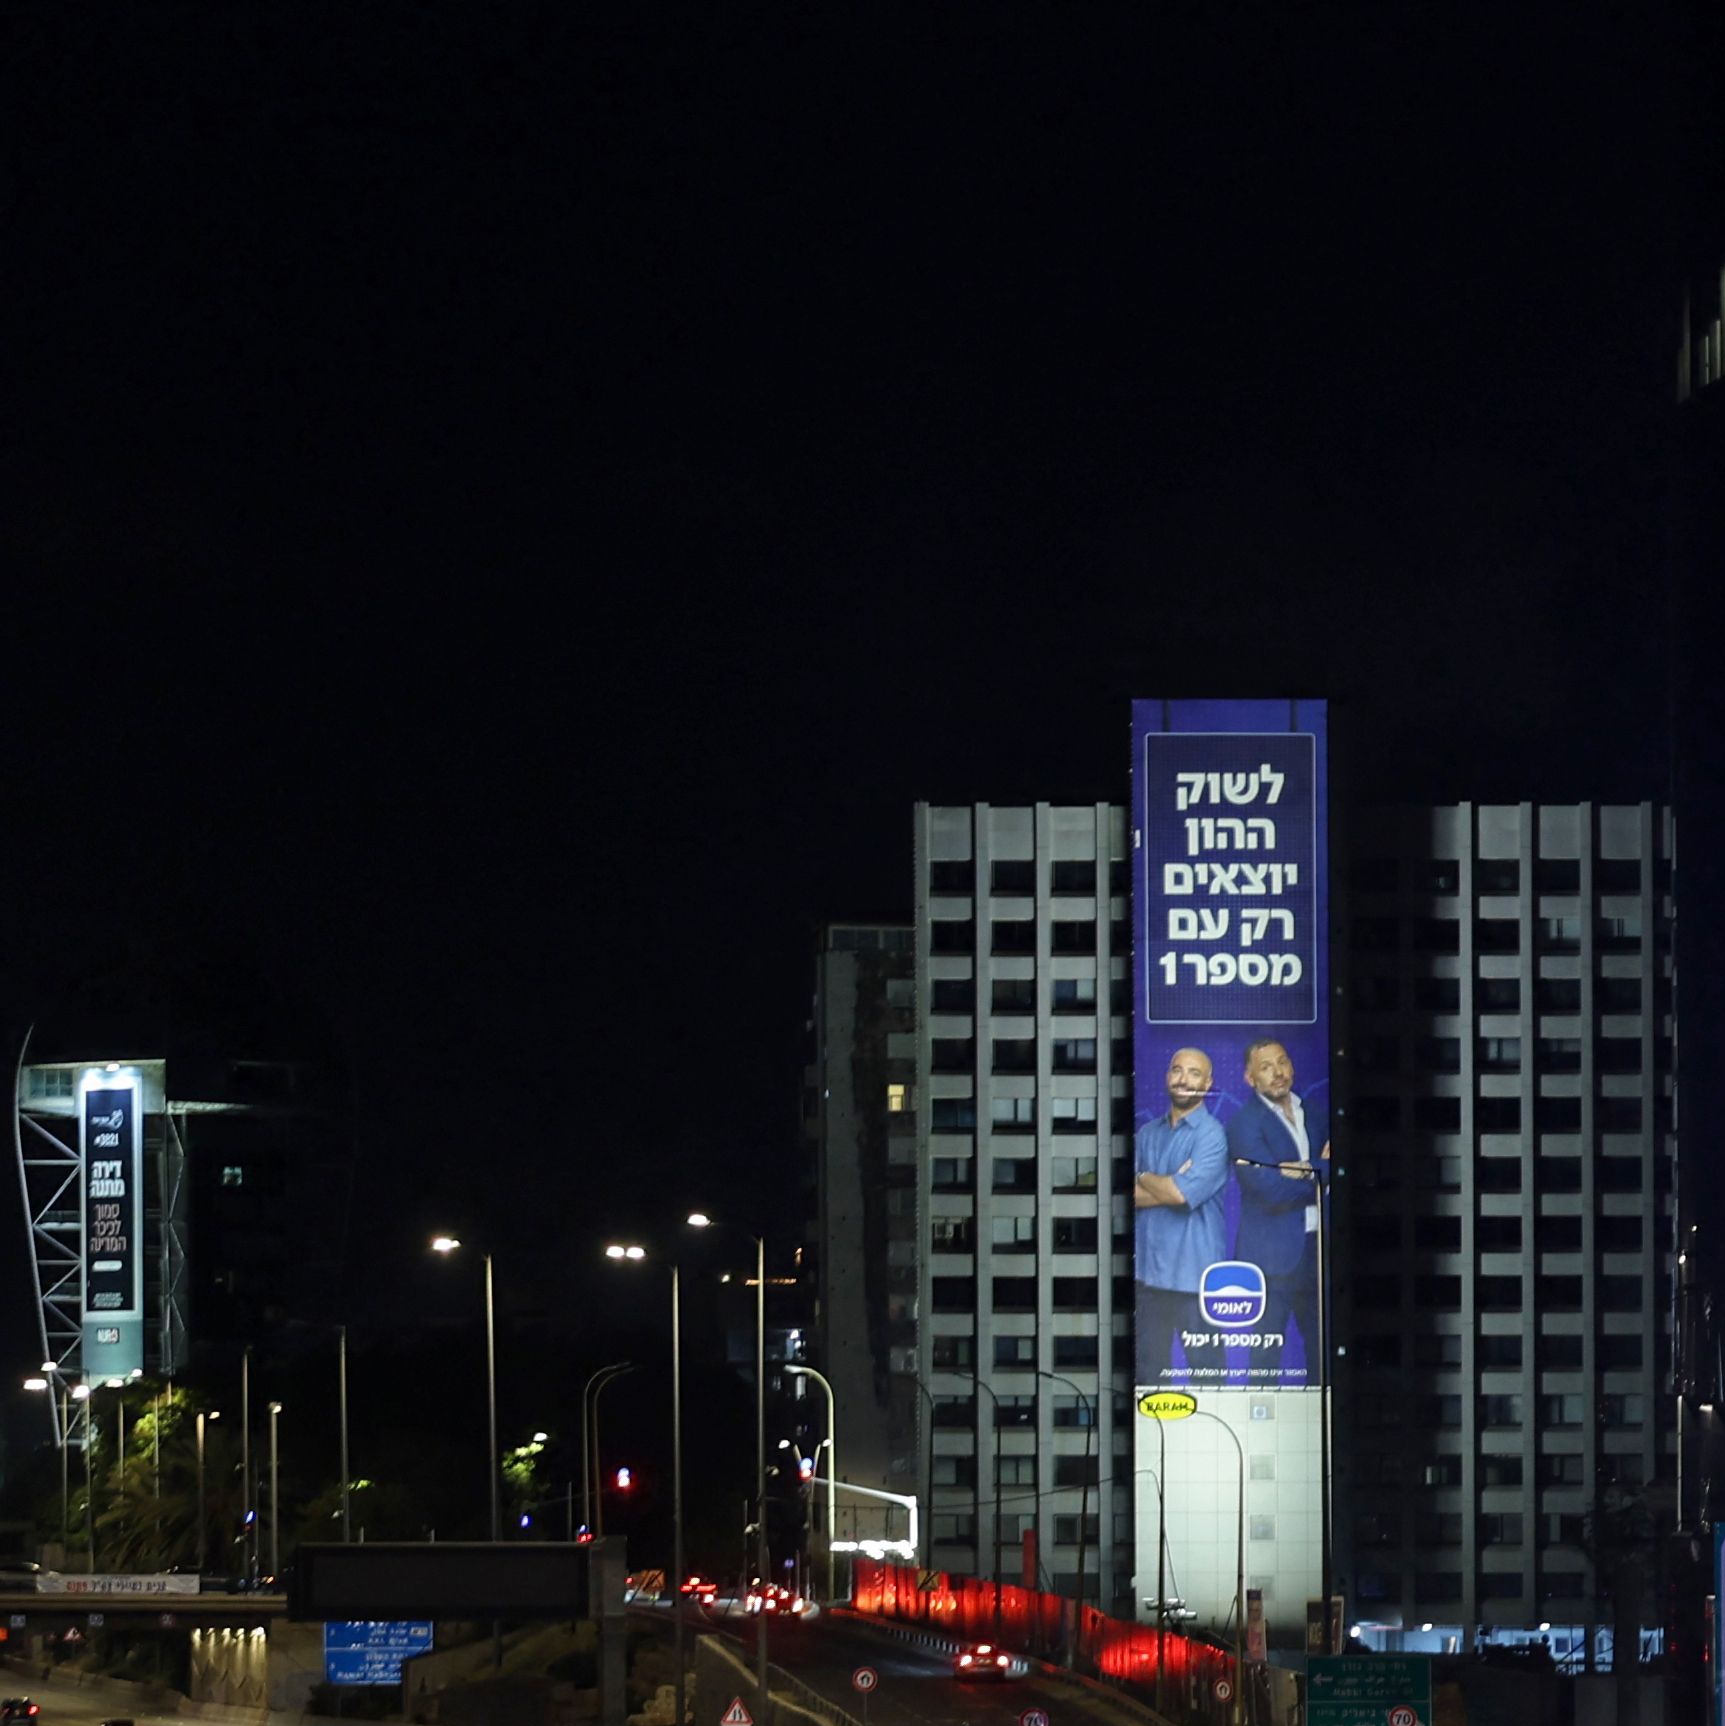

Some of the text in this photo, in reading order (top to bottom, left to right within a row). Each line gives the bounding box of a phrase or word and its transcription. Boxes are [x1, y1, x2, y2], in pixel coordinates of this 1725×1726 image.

[1176, 763, 1285, 811] לשוק
[1185, 817, 1276, 856] ההון
[1163, 863, 1298, 895] יוצאים
[1168, 908, 1295, 946] רק עם
[92, 1160, 122, 1178] דירה
[1212, 1301, 1252, 1315] לאומי
[1182, 1330, 1210, 1347] יכול
[1263, 1334, 1284, 1349] רק
[1395, 1713, 1410, 1726] 70
